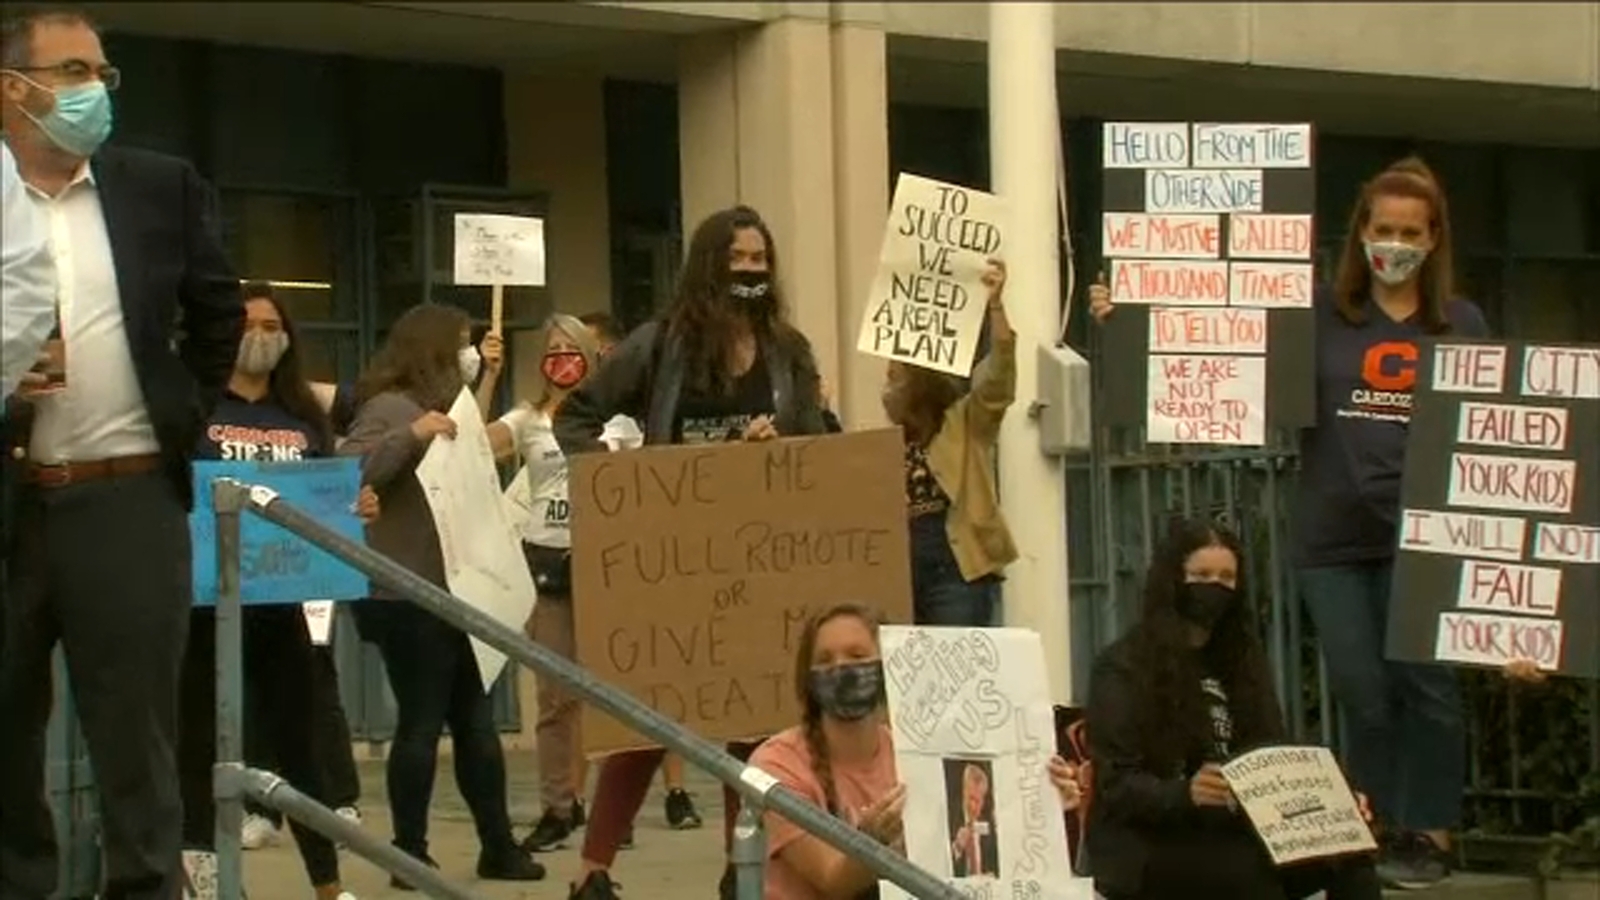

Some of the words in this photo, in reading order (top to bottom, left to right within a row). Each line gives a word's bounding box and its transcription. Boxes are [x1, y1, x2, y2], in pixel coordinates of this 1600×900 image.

[1111, 125, 1186, 164] HELLO
[1197, 124, 1255, 164] FROM
[1257, 127, 1305, 162] THE
[937, 187, 968, 216] TO
[1151, 171, 1217, 209] OTHER
[1219, 171, 1261, 208] SIDE
[899, 204, 1001, 254] SUCCEED
[1106, 217, 1141, 249] WE
[1230, 216, 1309, 253] CALLED
[919, 243, 957, 276] WE
[892, 272, 968, 311] NEED
[1114, 263, 1132, 300] A
[1134, 262, 1226, 299] THOUSAND
[1235, 268, 1307, 303] TIMES
[872, 300, 893, 326] A
[900, 304, 957, 337] REAL
[1152, 308, 1176, 346] TO
[1177, 310, 1221, 345] TELL
[1223, 309, 1264, 345] YOU
[874, 326, 958, 366] PLAN
[1364, 341, 1418, 391] C
[1164, 358, 1192, 380] WE
[1197, 358, 1239, 380] ARE
[1436, 348, 1502, 388] THE
[1154, 400, 1217, 420] READY
[1221, 400, 1249, 421] TO
[1168, 380, 1219, 401] NOT
[1175, 422, 1243, 441] OPEN
[1466, 406, 1562, 446] FAILED
[592, 453, 718, 517] GIVE
[765, 444, 817, 493] ME
[1456, 456, 1521, 499] YOUR
[1522, 464, 1571, 509] KIDS
[600, 535, 730, 588] FULL
[735, 521, 890, 574] REMOTE
[1404, 512, 1431, 546] I
[1444, 516, 1519, 553] WILL
[1539, 525, 1600, 561] NOT
[714, 580, 749, 610] OR
[1472, 564, 1553, 611] FAIL
[608, 614, 728, 673] GIVE
[783, 605, 810, 652] M
[1445, 615, 1508, 658] YOUR
[1509, 622, 1558, 664] KIDS
[649, 672, 787, 725] DEAT
[952, 679, 1013, 751] US
